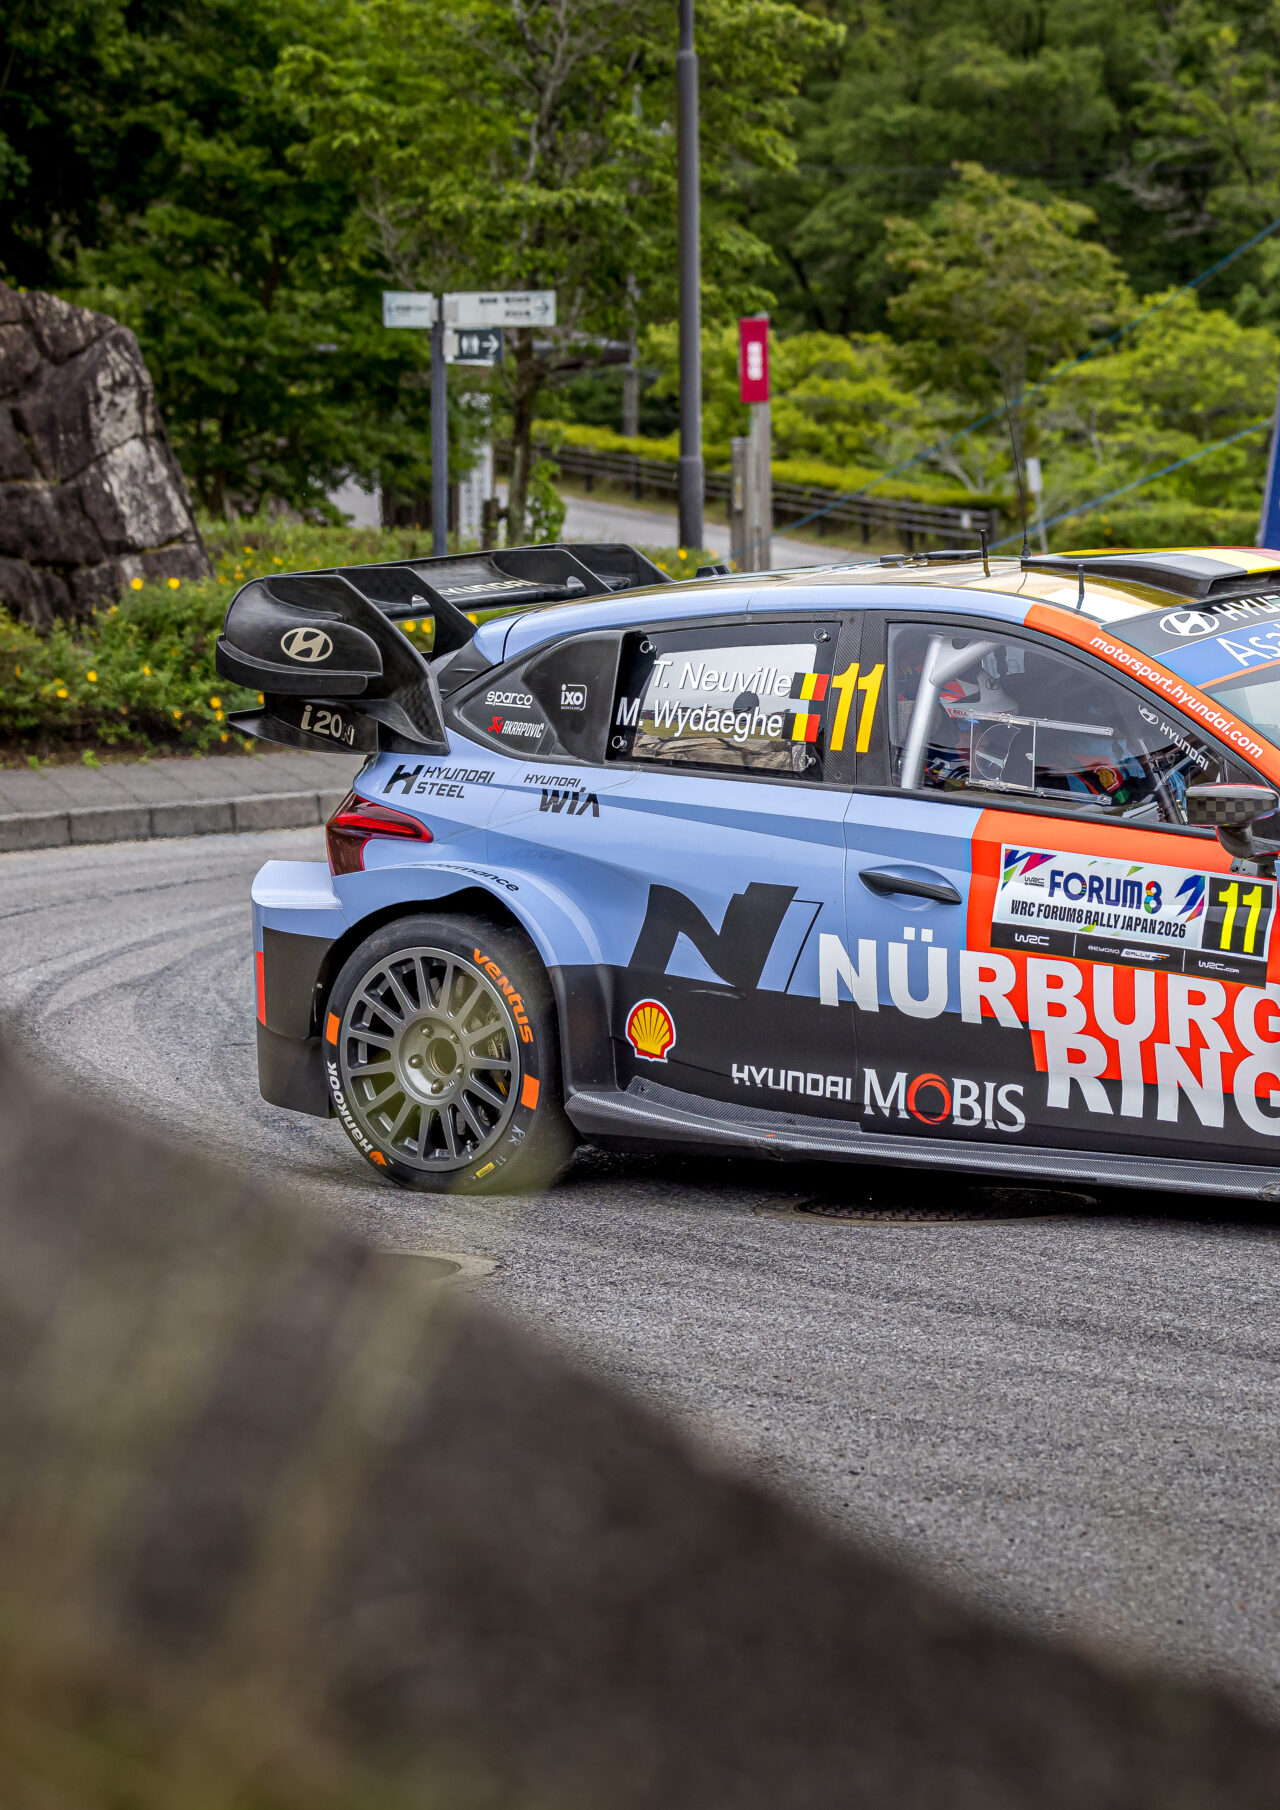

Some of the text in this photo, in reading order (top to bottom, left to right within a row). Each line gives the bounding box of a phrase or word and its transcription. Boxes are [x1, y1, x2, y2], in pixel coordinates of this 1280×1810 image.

[652, 659, 793, 698] T. Neuville
[1089, 636, 1264, 760] motorsport.hyundai.com
[485, 690, 533, 709] sparco
[828, 662, 886, 754] 11
[615, 696, 784, 743] M. Wydaeghe
[1159, 721, 1210, 772] HYUNDAI
[414, 781, 465, 799] STEEL
[422, 767, 496, 785] HYUNDAI
[523, 773, 582, 788] HYUNDAI
[538, 787, 600, 818] WIA
[1048, 869, 1163, 915] FORUM8
[1010, 899, 1187, 939] WRC FORUM8 RALLY JAPAN 2026
[1217, 881, 1263, 954] 11
[1014, 932, 1050, 946] WRC
[1087, 945, 1151, 959] BEYOND RALLY
[731, 1063, 1027, 1133] HYUNDAI MOBIS
